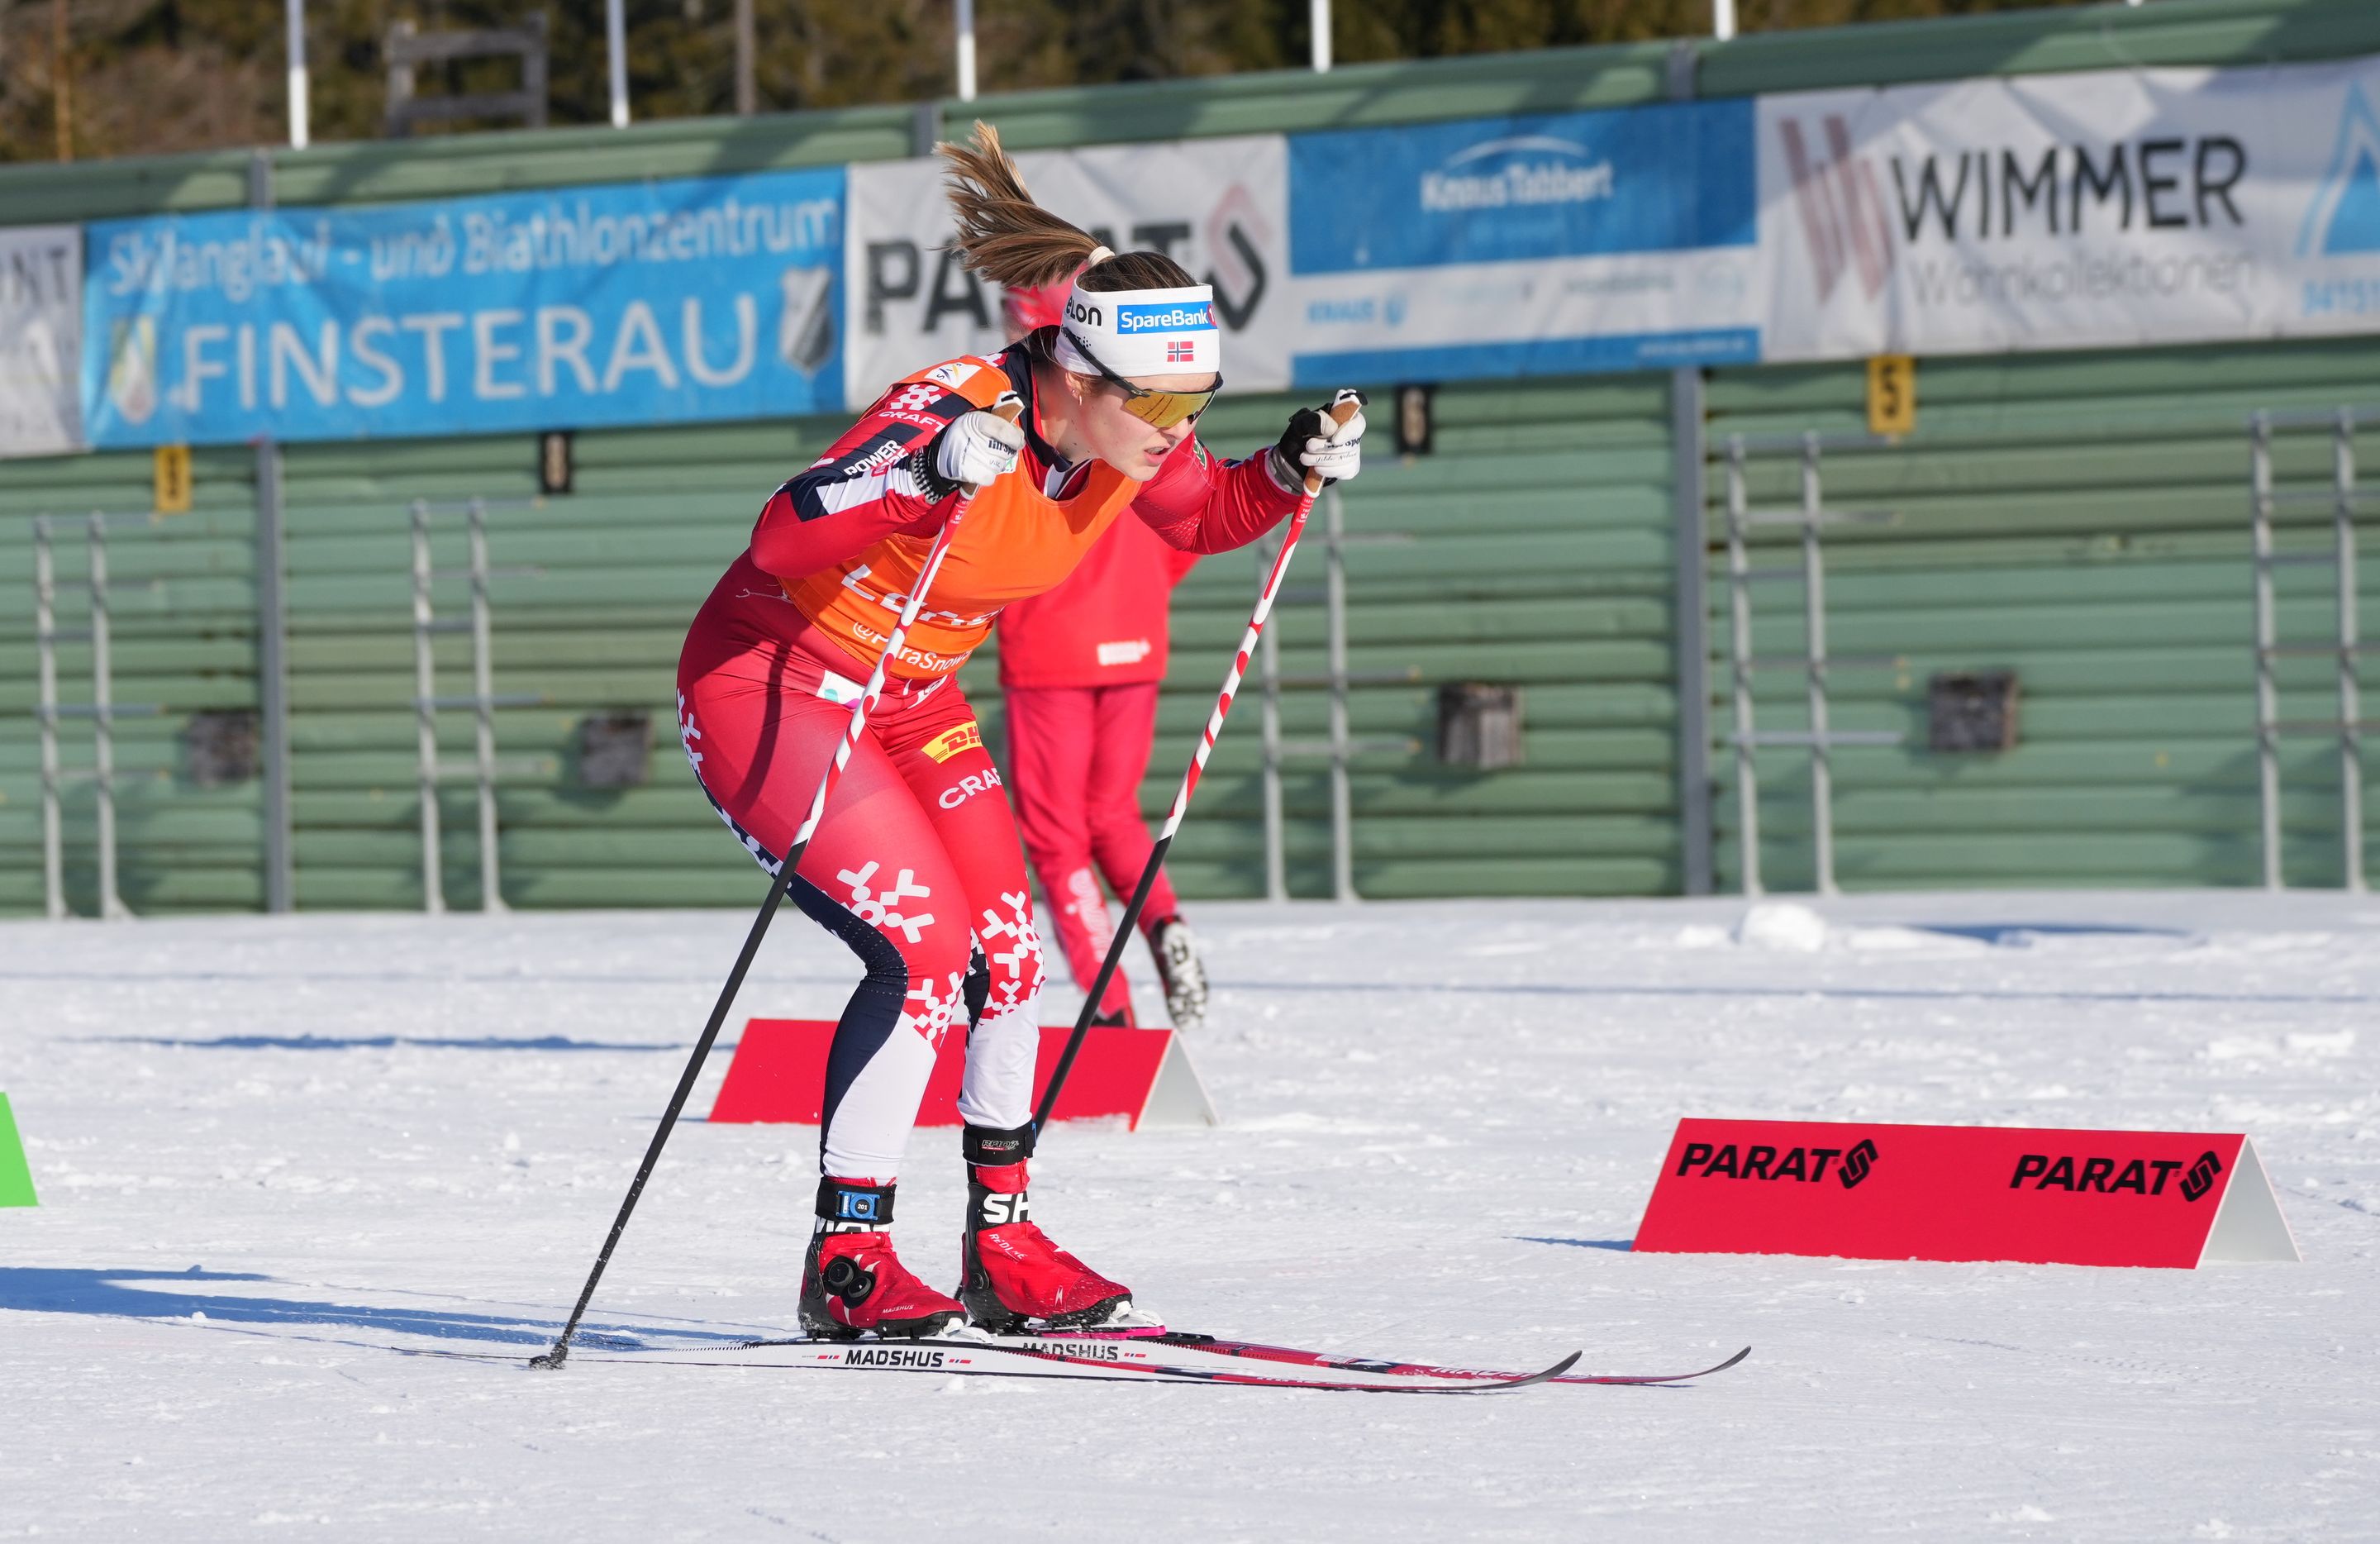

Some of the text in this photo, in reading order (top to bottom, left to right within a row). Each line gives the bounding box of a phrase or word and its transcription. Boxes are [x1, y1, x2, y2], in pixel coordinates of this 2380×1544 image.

[1890, 137, 2248, 243] WIMMER
[370, 213, 455, 282] und
[462, 195, 838, 274] Biathlonzentrum
[868, 222, 1191, 334] PAT
[1121, 310, 1208, 332] SpareBank
[183, 293, 757, 412] FINSTERAU
[1880, 364, 1901, 419] 5
[878, 410, 946, 433] CRAFT
[843, 439, 902, 476] POWER
[1676, 1142, 1841, 1183] PARAT
[2009, 1154, 2182, 1195] PARAT
[845, 1350, 945, 1367] MADSHUS
